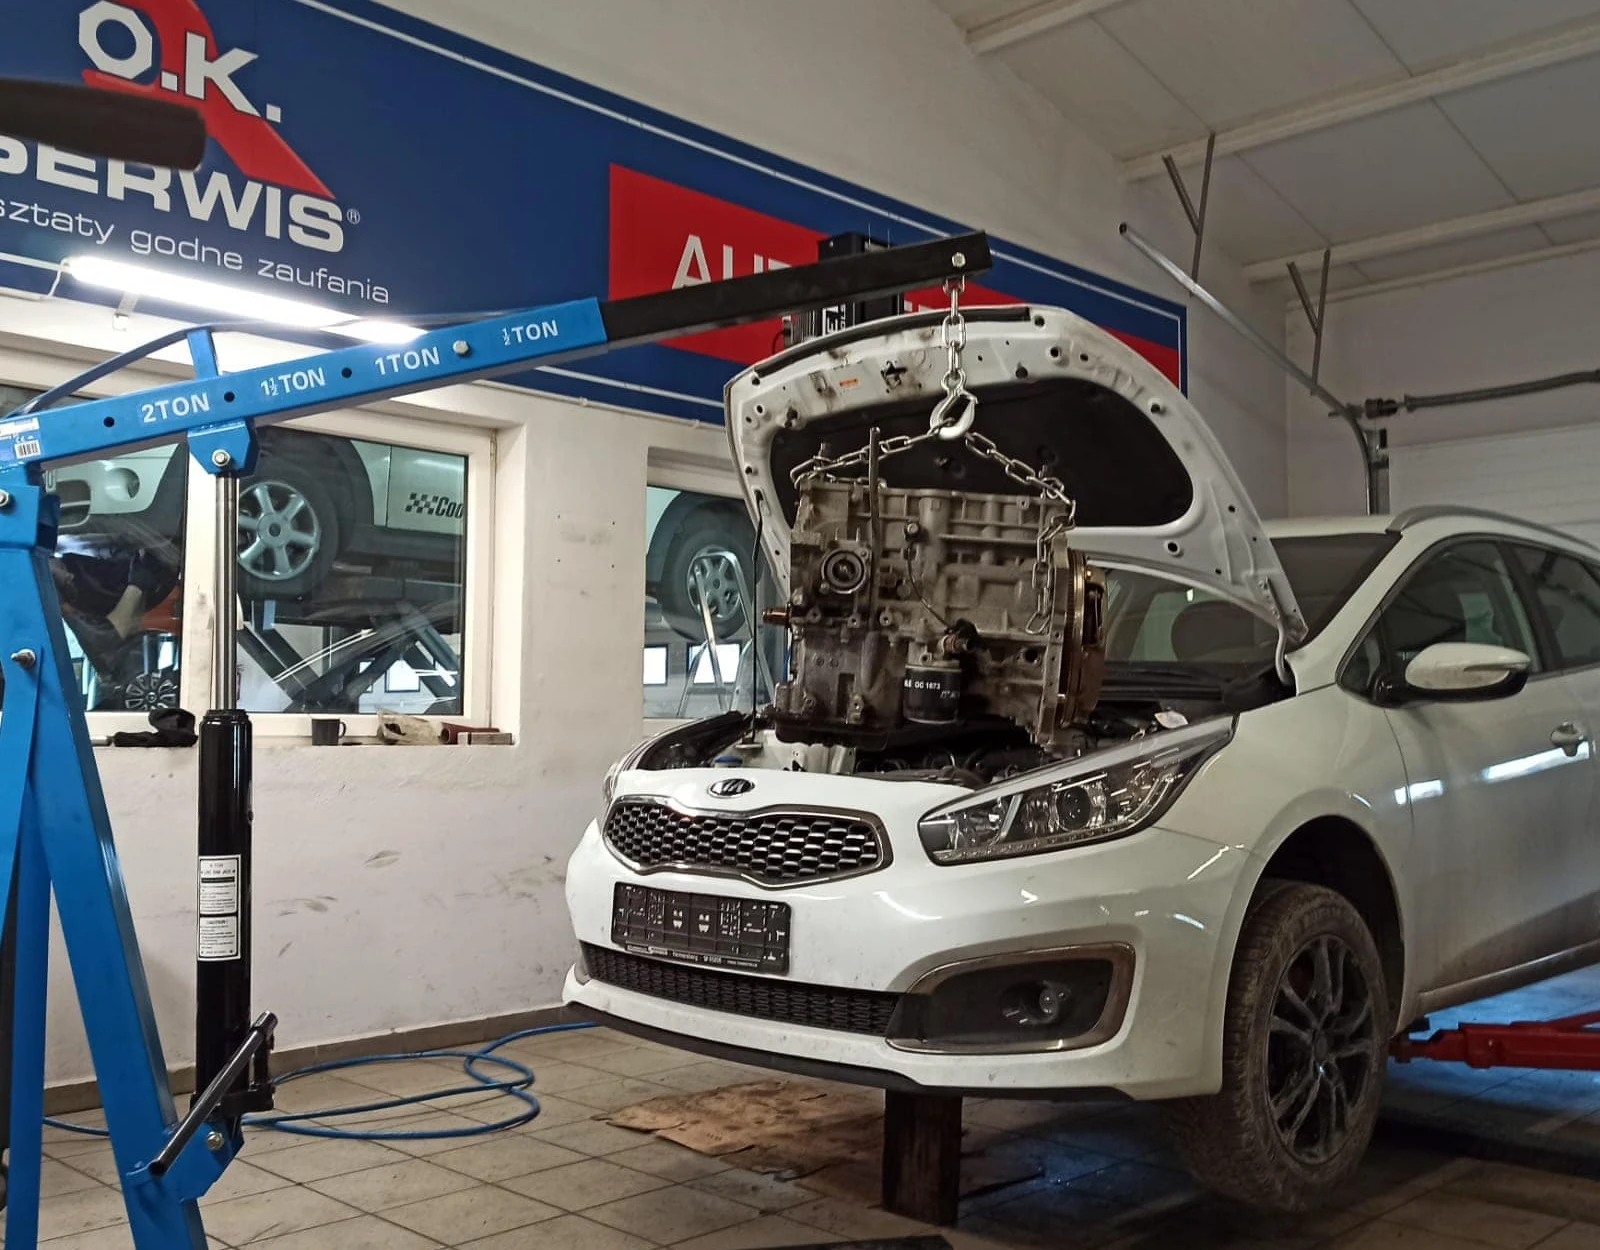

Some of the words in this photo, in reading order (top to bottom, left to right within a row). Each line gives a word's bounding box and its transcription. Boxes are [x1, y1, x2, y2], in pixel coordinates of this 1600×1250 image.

[79, 1, 281, 123] O.K.
[131, 229, 243, 271] godne
[258, 258, 389, 304] zaufania
